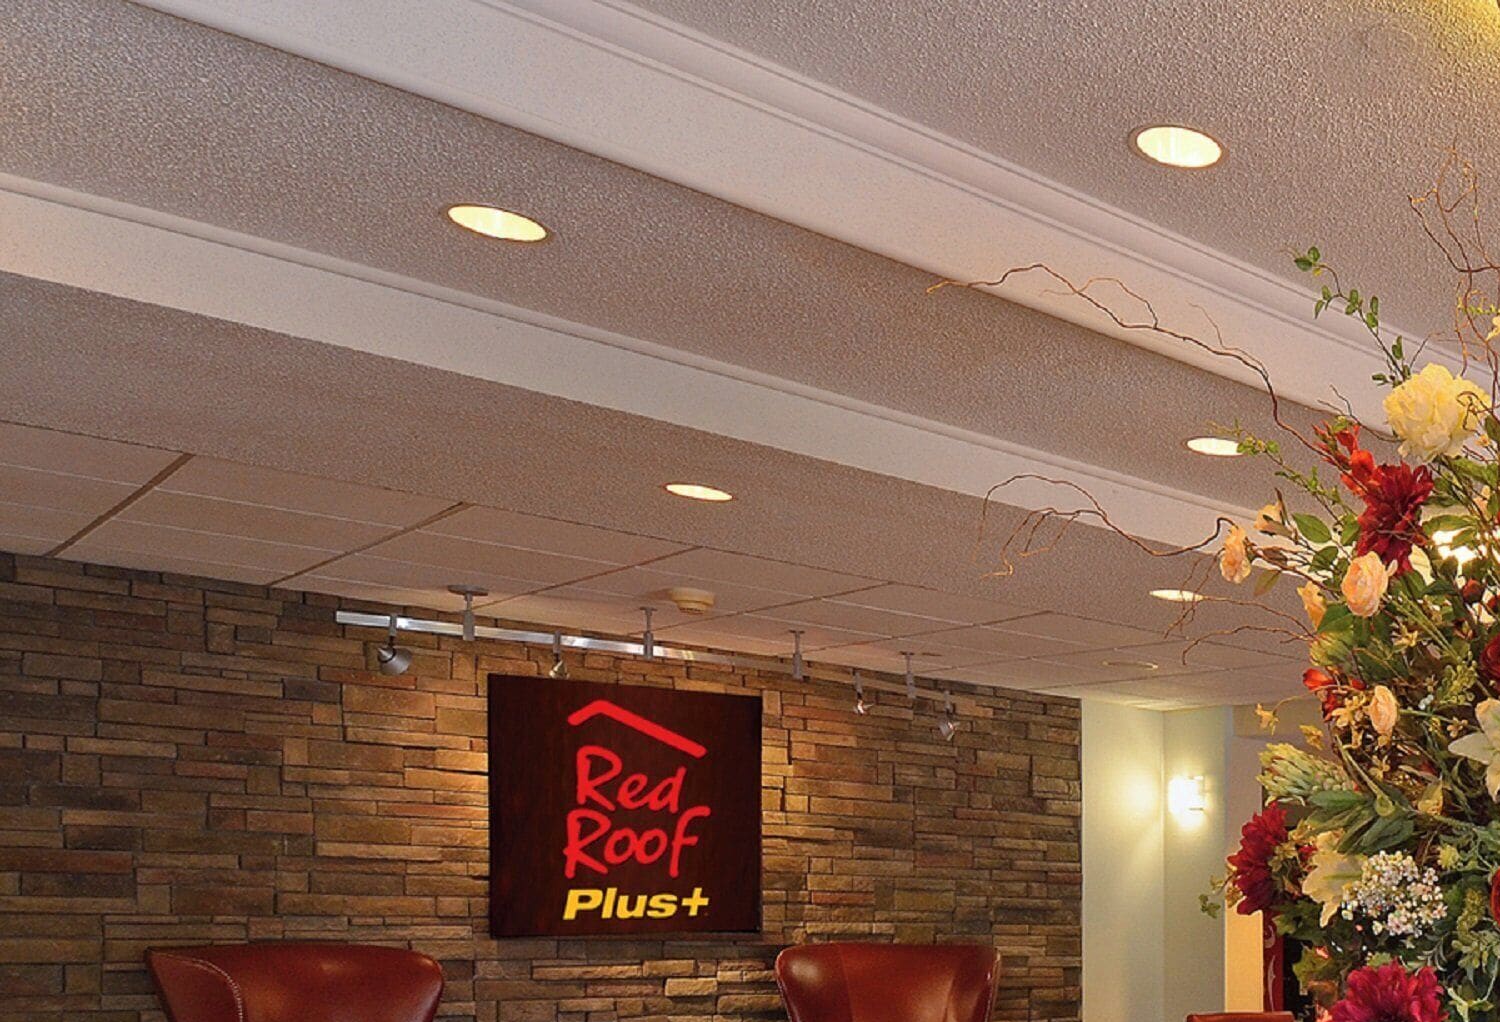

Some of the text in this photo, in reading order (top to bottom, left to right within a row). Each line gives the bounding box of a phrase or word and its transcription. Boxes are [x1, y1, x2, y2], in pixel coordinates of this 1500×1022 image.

[577, 745, 686, 814] Red
[563, 805, 711, 879] Roof
[563, 887, 710, 920] Plus+
